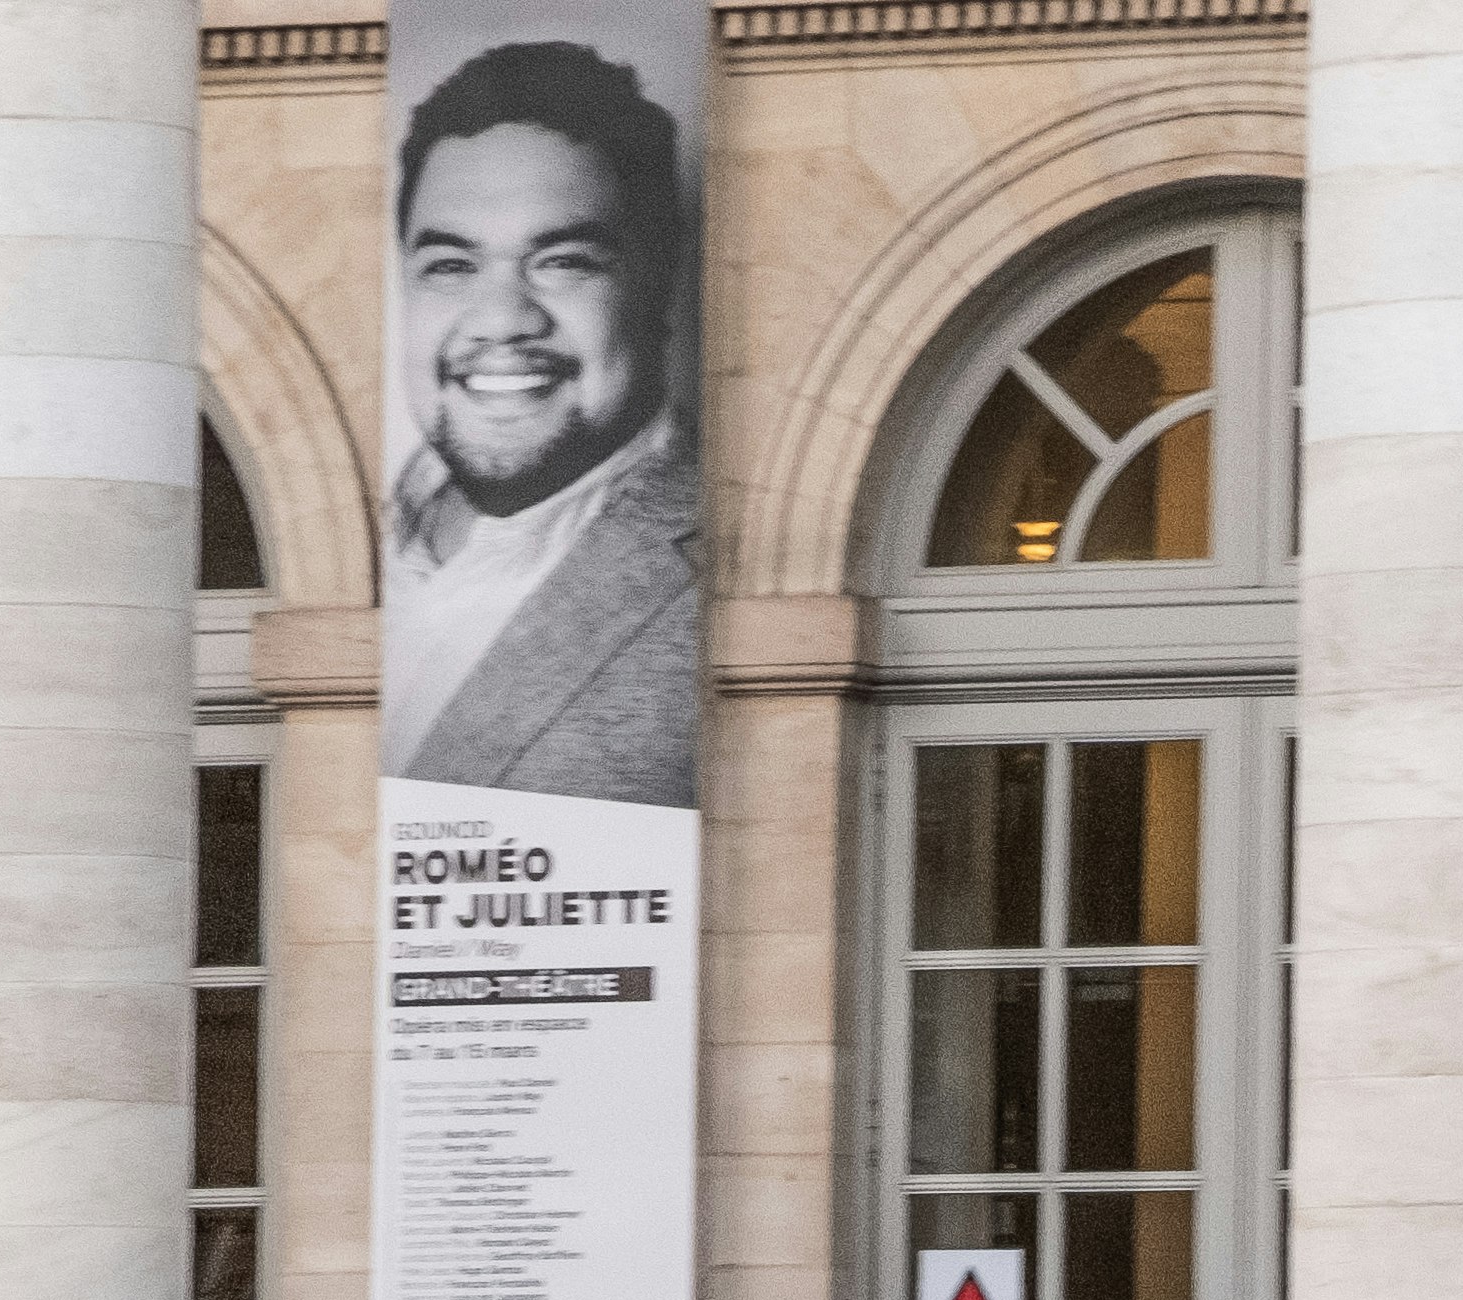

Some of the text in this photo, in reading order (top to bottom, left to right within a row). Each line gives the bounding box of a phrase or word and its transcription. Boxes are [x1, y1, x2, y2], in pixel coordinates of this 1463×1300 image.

[393, 837, 552, 885] ROMÉO
[393, 888, 671, 930] ET JULIETTE
